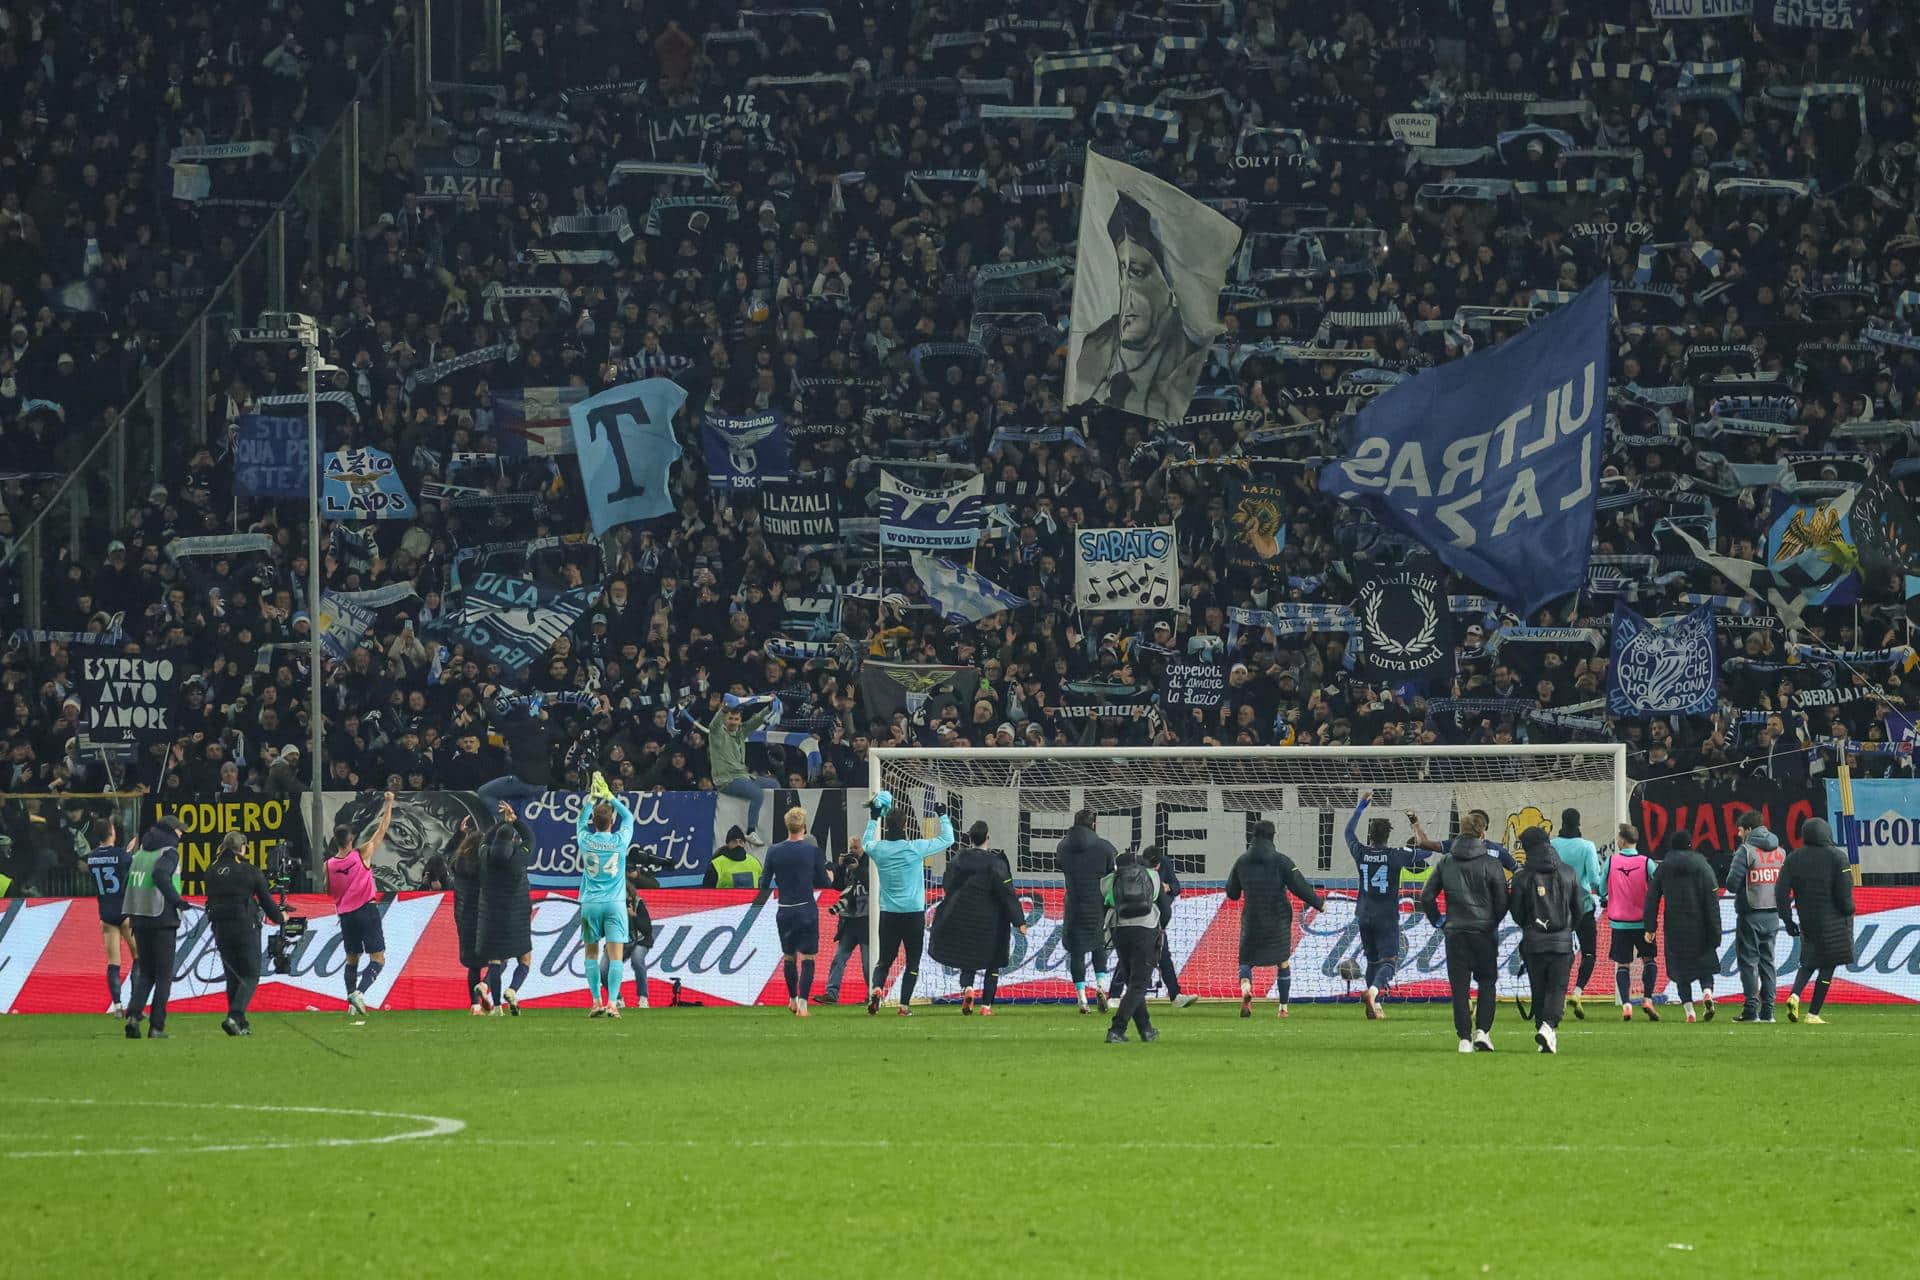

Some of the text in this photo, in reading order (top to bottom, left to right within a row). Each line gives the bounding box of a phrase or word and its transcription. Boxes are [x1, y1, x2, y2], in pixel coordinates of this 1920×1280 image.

[249, 330, 289, 338] LAZIO
[1326, 384, 1376, 397] LAZIO
[239, 440, 275, 464] QUA
[586, 397, 652, 505] T
[1242, 485, 1281, 496] LAZIO
[770, 493, 830, 512] LAZIALI
[763, 516, 801, 535] SONO
[886, 532, 972, 546] WONDERWALL
[1079, 529, 1169, 563] SABATO
[1360, 580, 1378, 600] no
[1716, 616, 1775, 628] S.S. LAZIO
[1370, 646, 1444, 673] curva nord
[1630, 650, 1648, 665] IO
[1687, 649, 1708, 667] HO
[84, 657, 174, 682] ESTREMO
[1166, 664, 1222, 680] colpevoli
[1684, 663, 1707, 681] CHE
[99, 682, 158, 704] ATTO
[1168, 677, 1224, 690] di amare
[1626, 682, 1648, 698] HO
[1167, 687, 1221, 706] la Lazio
[1680, 694, 1697, 707] TO
[90, 705, 168, 729] D'AMORE
[90, 867, 120, 895] 13
[1359, 863, 1402, 893] 14
